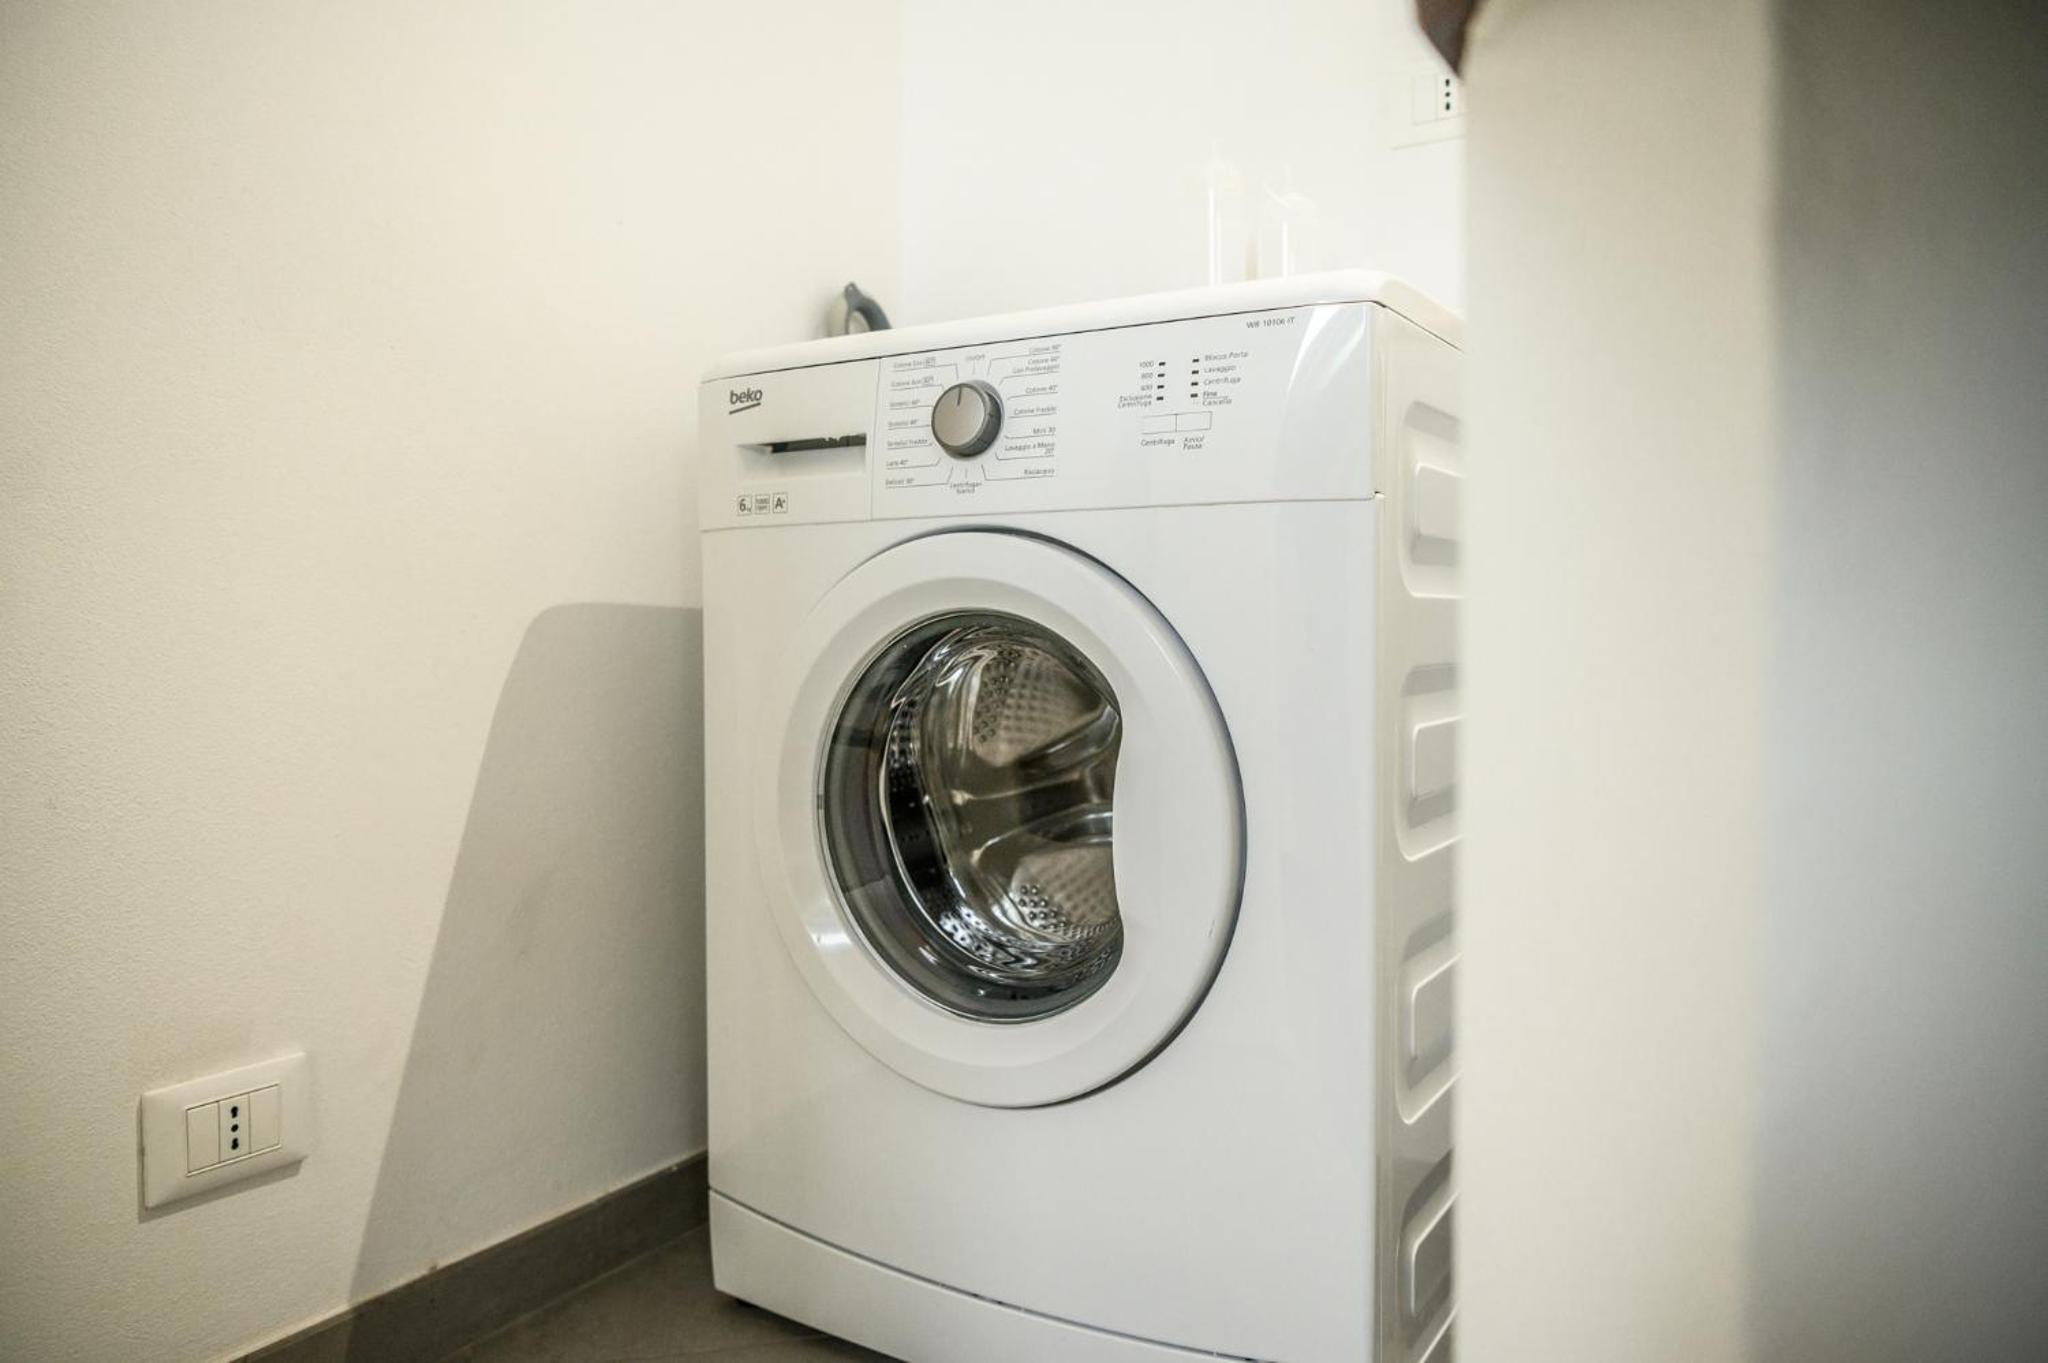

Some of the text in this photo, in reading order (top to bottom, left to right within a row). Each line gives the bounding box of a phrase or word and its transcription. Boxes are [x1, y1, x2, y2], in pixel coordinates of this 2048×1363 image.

[1229, 351, 1248, 360] Porta
[1204, 365, 1237, 374] Lavaggio
[1203, 376, 1242, 387] Centrifuga
[730, 387, 763, 405] beko
[1117, 400, 1152, 410] Centrifuga
[1140, 438, 1175, 448] Centrifuga
